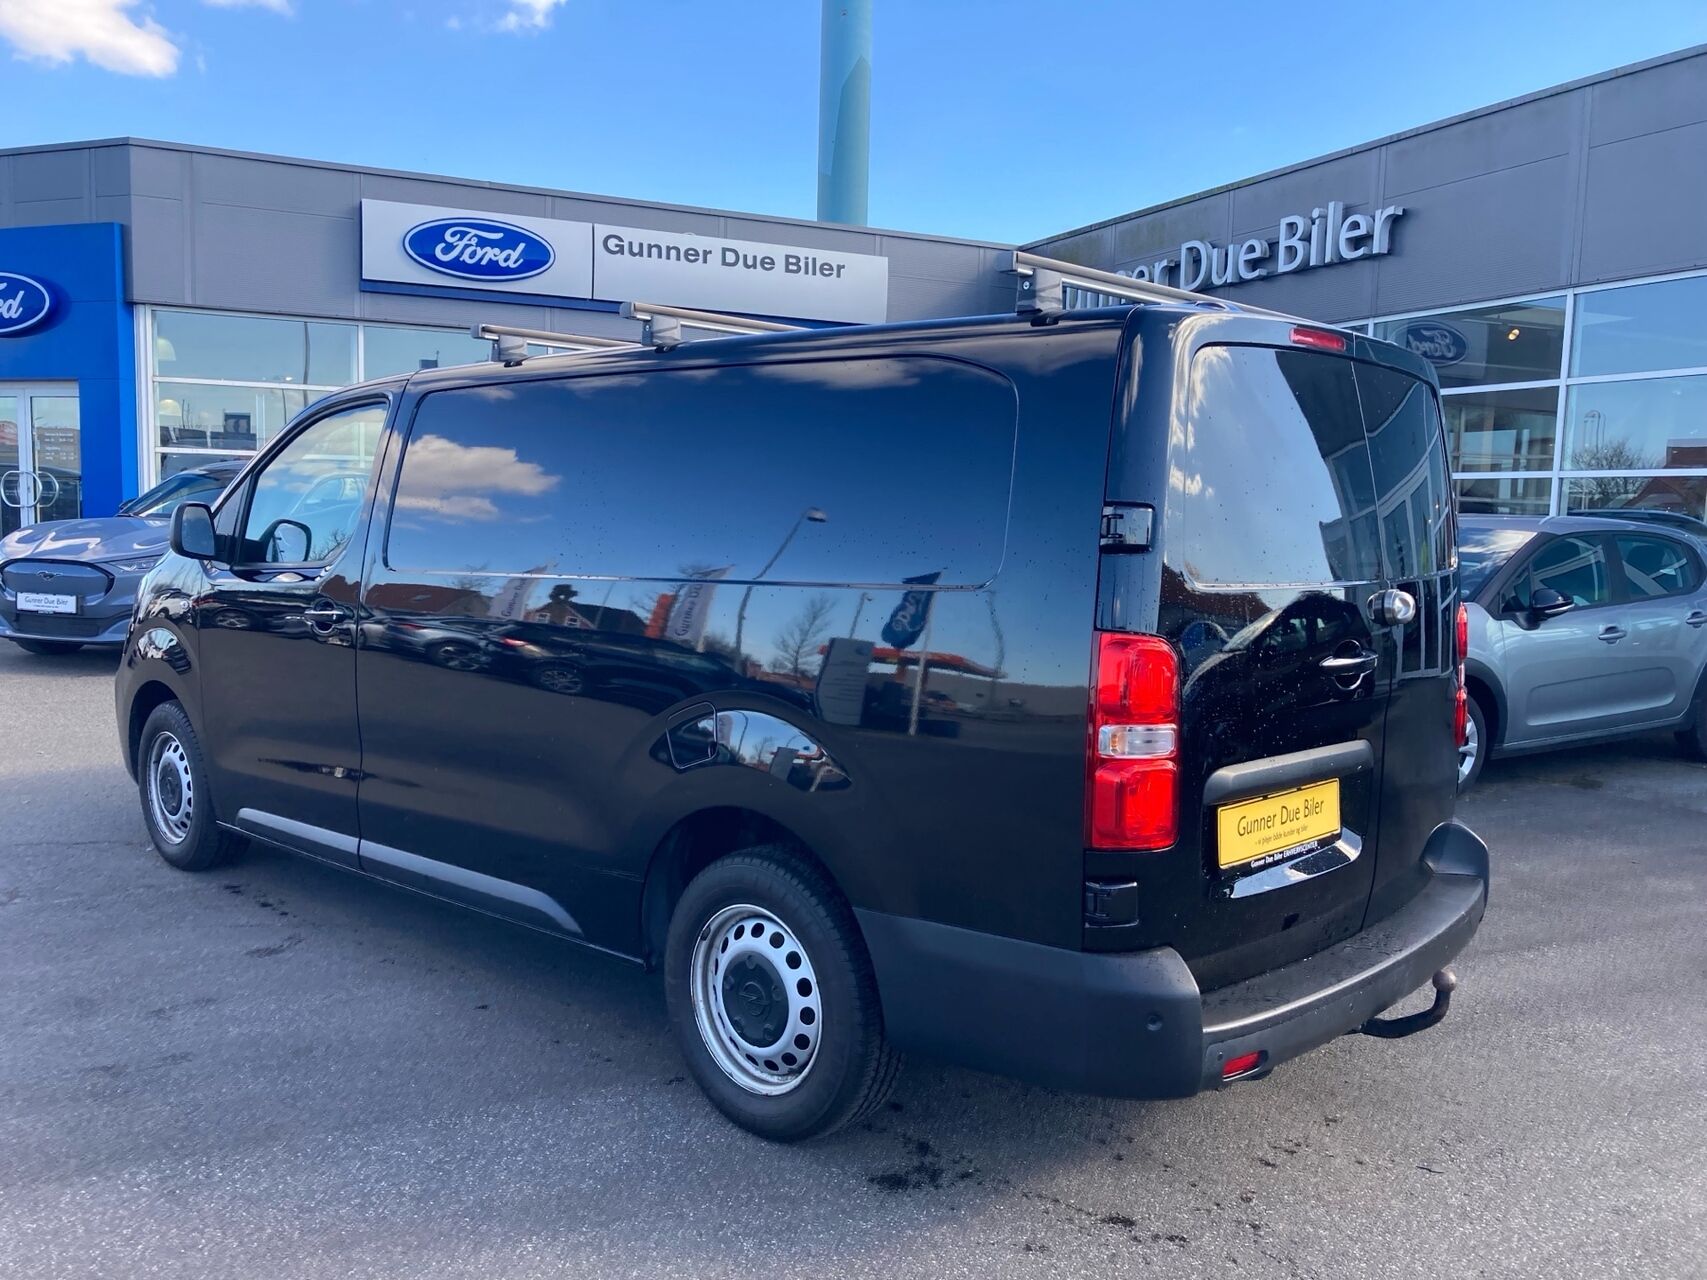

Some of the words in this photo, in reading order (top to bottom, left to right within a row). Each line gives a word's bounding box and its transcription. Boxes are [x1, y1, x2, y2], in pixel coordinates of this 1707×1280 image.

[435, 226, 526, 269] Ford
[602, 234, 712, 265] Gunner
[721, 247, 776, 271] Due
[784, 254, 846, 279] Biler
[1180, 239, 1269, 292] Due
[1277, 201, 1403, 273] Biler
[1237, 815, 1277, 837] Gunner
[1280, 805, 1301, 826] Due
[1304, 797, 1325, 818] Biler
